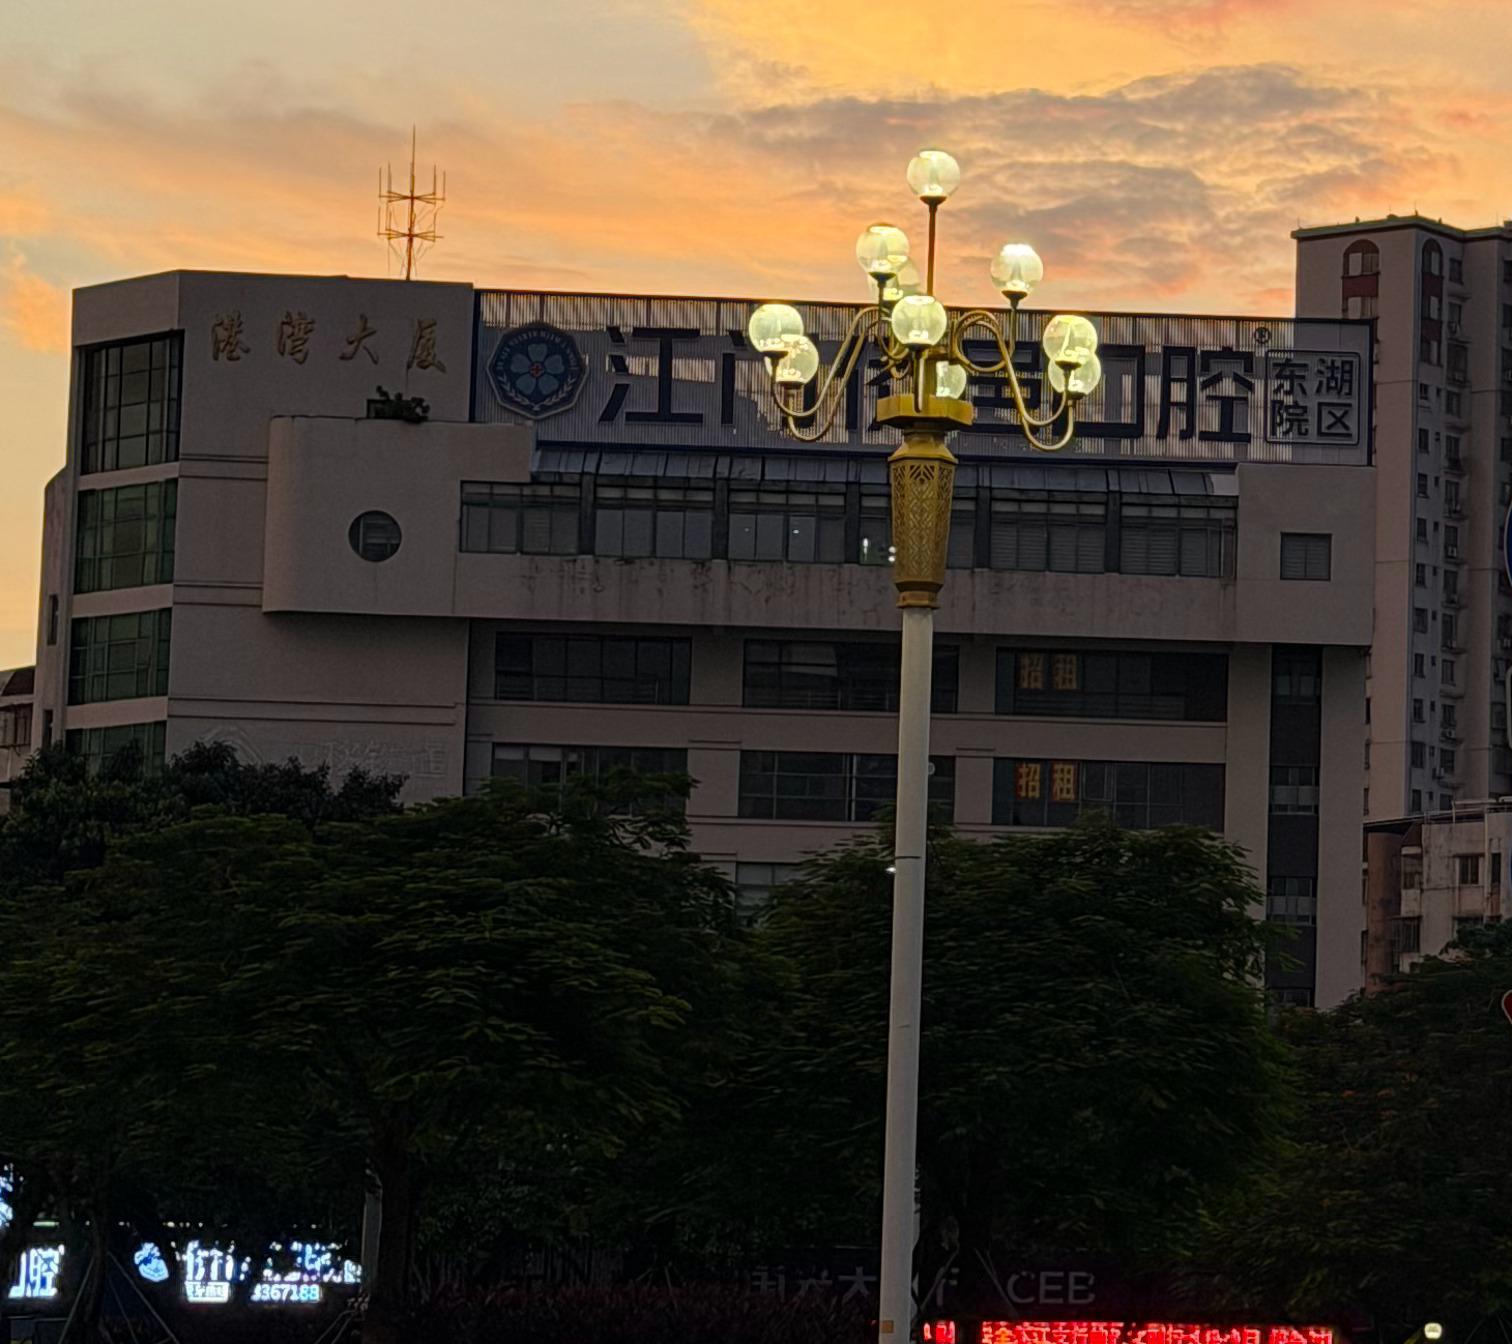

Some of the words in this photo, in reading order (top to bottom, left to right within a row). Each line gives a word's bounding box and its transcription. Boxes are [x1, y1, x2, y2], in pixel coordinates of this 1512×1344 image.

[1272, 358, 1354, 396] 东湖
[1271, 400, 1353, 437] 院区
[1014, 761, 1077, 801] 招租
[1007, 1270, 1096, 1305] CEB
